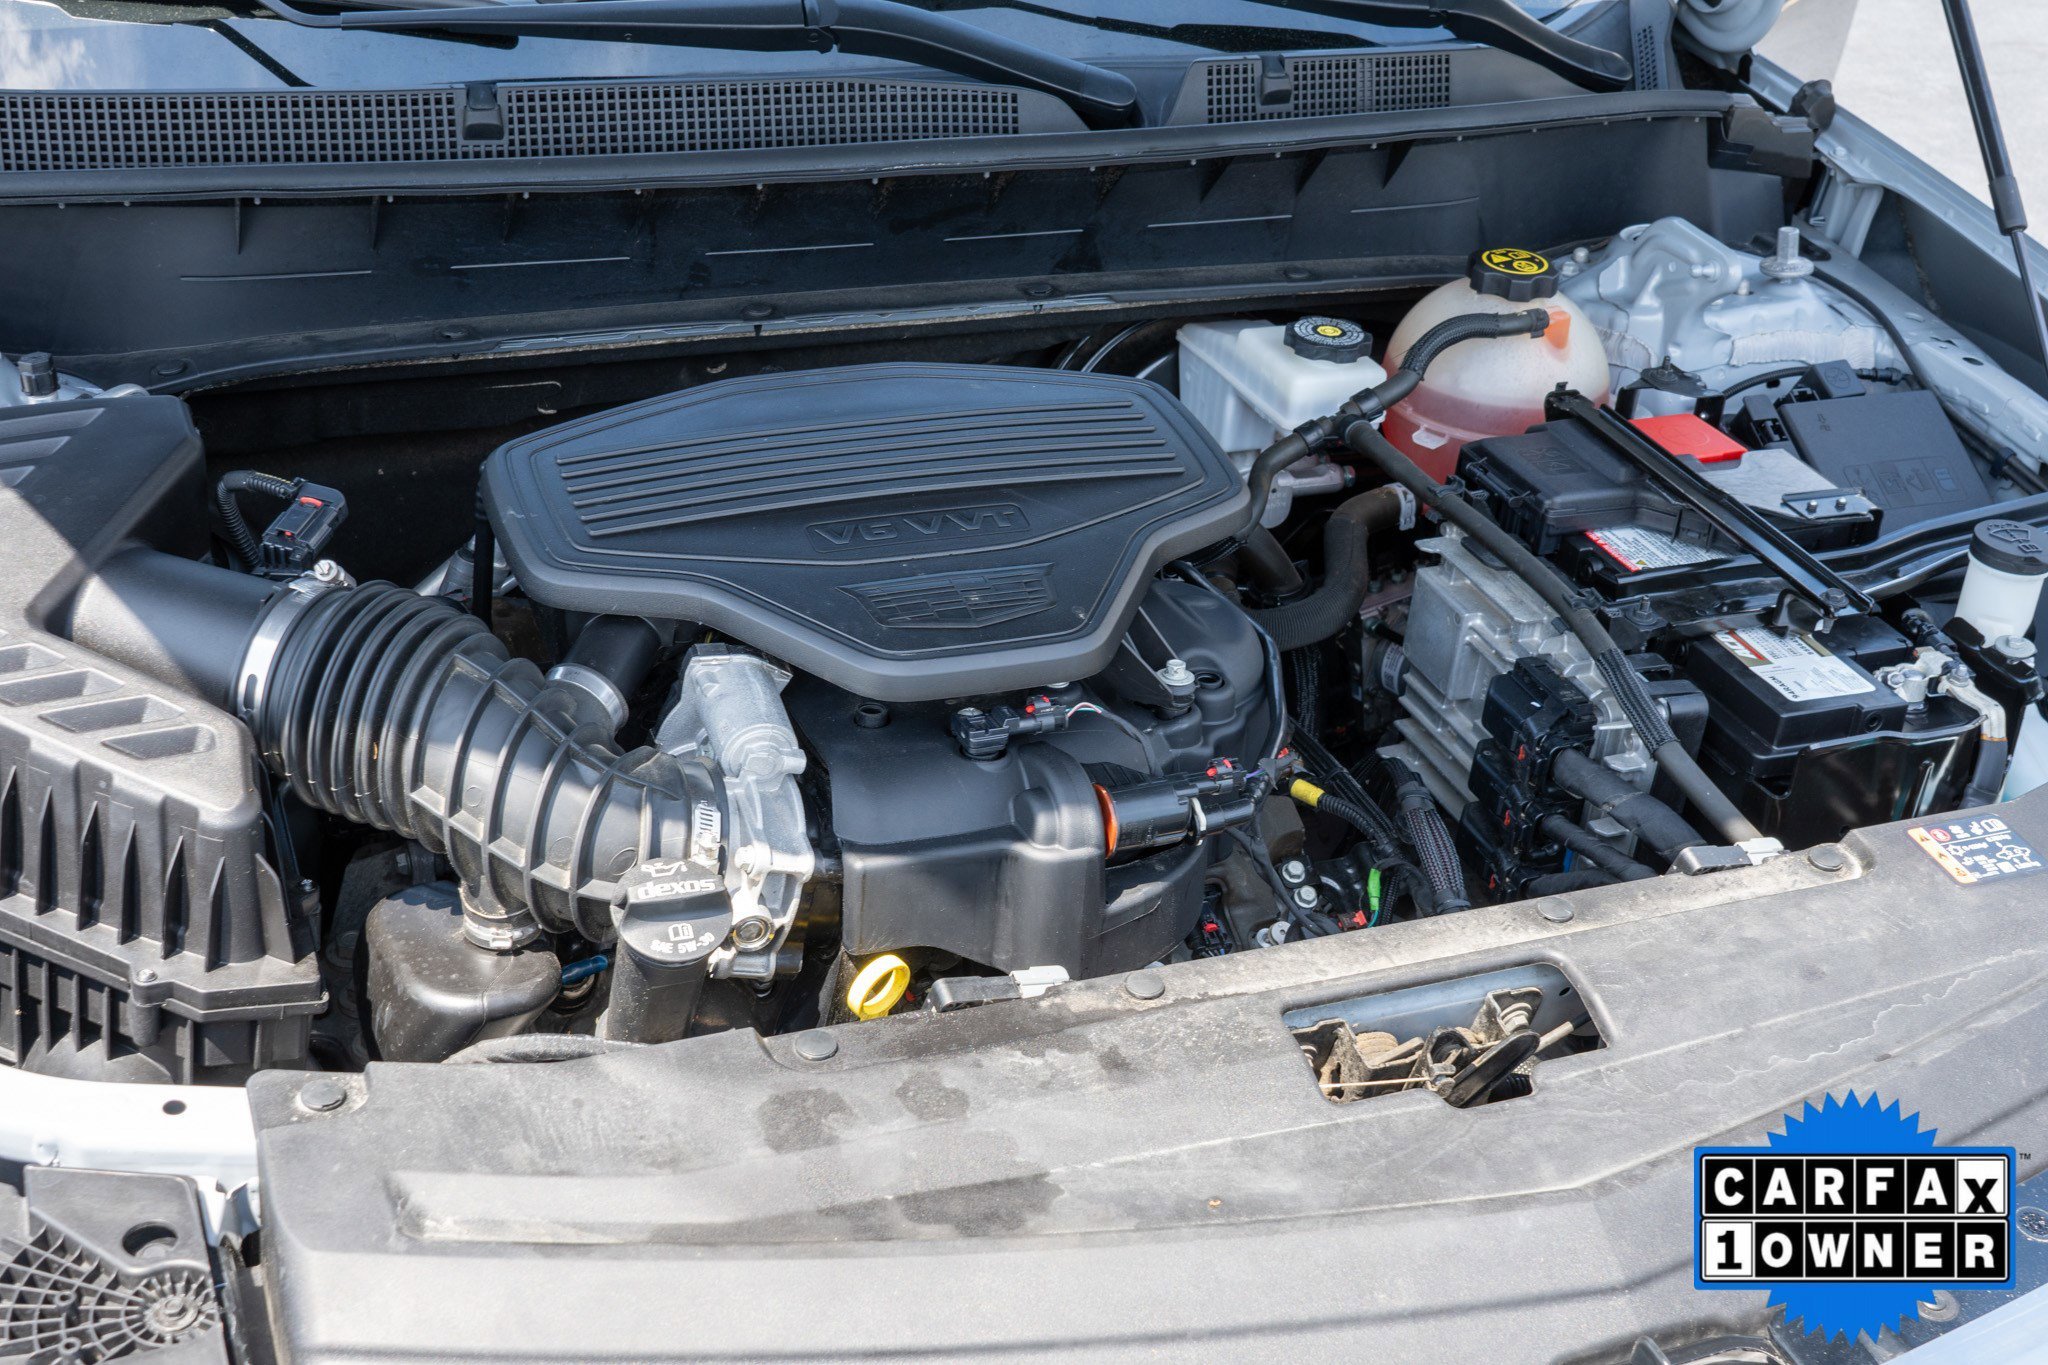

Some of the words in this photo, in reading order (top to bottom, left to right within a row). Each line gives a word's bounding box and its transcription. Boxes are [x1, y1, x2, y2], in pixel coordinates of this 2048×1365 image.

[813, 522, 898, 545] V6
[903, 510, 1016, 535] VVT
[637, 879, 716, 900] dexos
[650, 940, 674, 954] SAE
[677, 932, 716, 954] 5W-30
